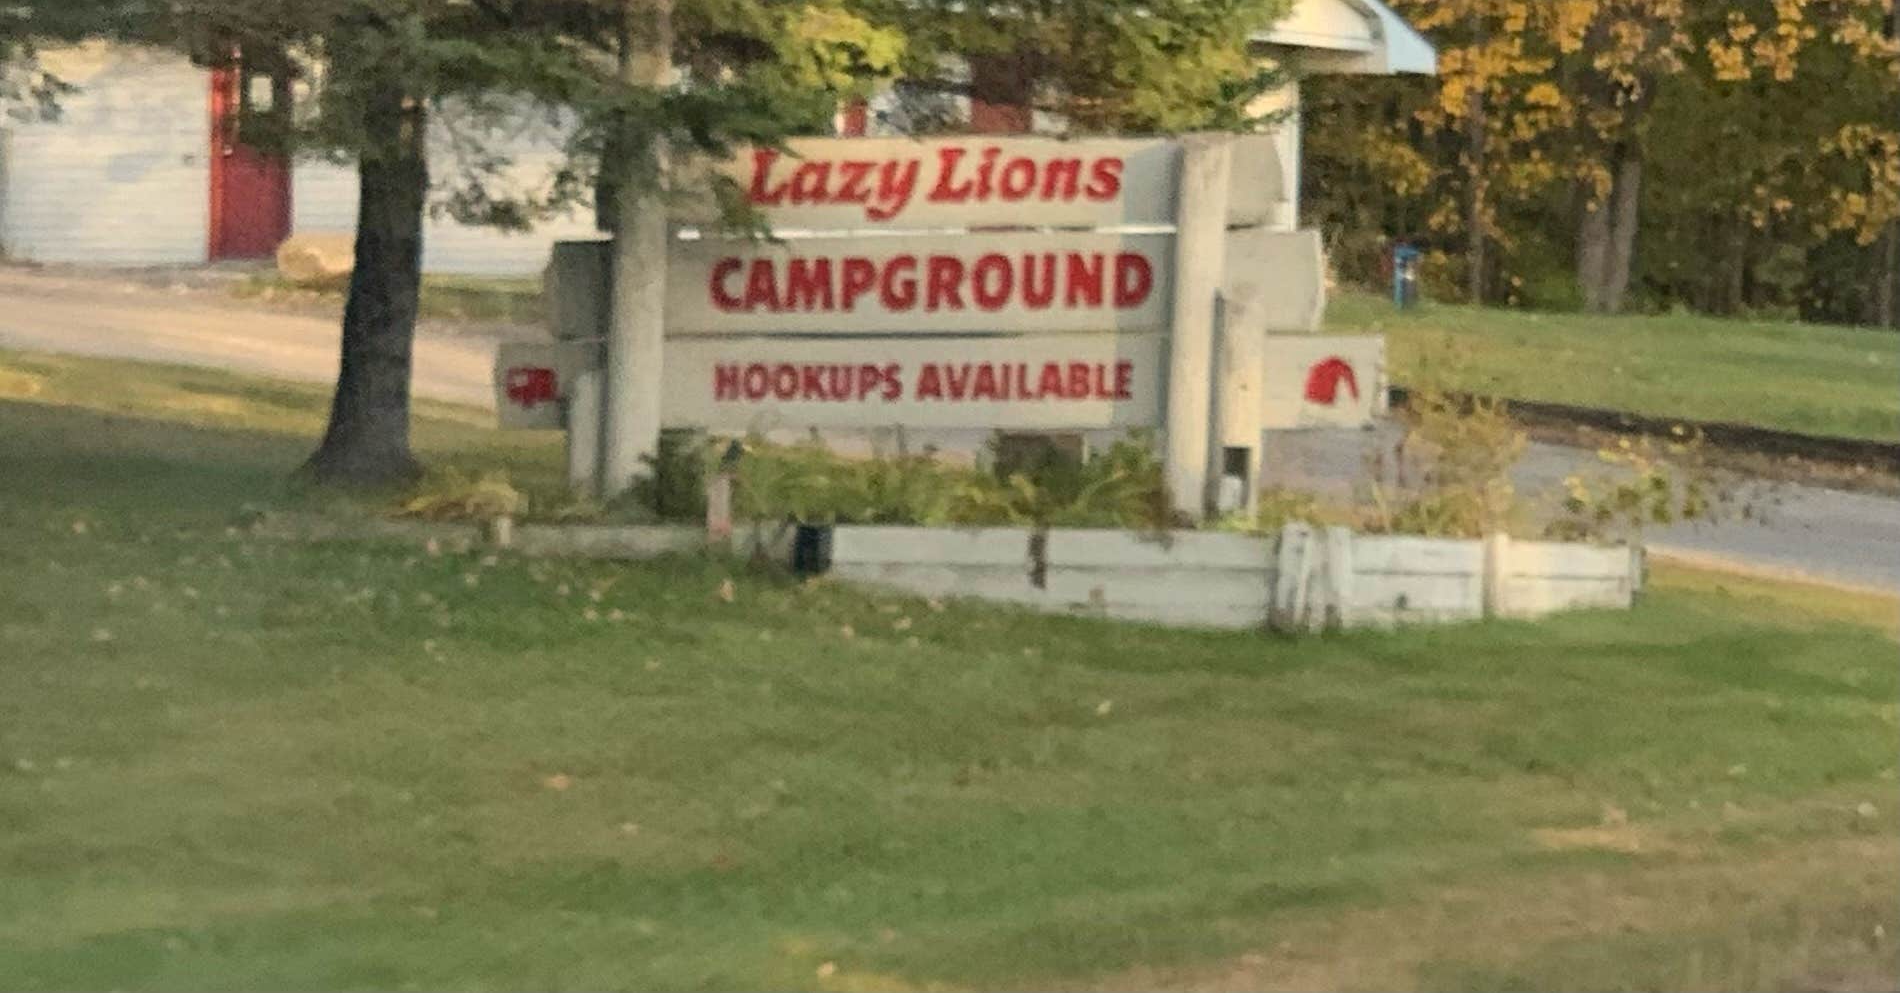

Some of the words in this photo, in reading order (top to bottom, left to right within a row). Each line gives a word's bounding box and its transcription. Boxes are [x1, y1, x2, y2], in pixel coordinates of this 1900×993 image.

[748, 148, 920, 221] Lazy
[926, 146, 1124, 202] Lions
[710, 252, 1153, 312] CAMPGROUND
[714, 362, 900, 401] HOOKUPS
[917, 359, 1132, 401] AVAILABLE
